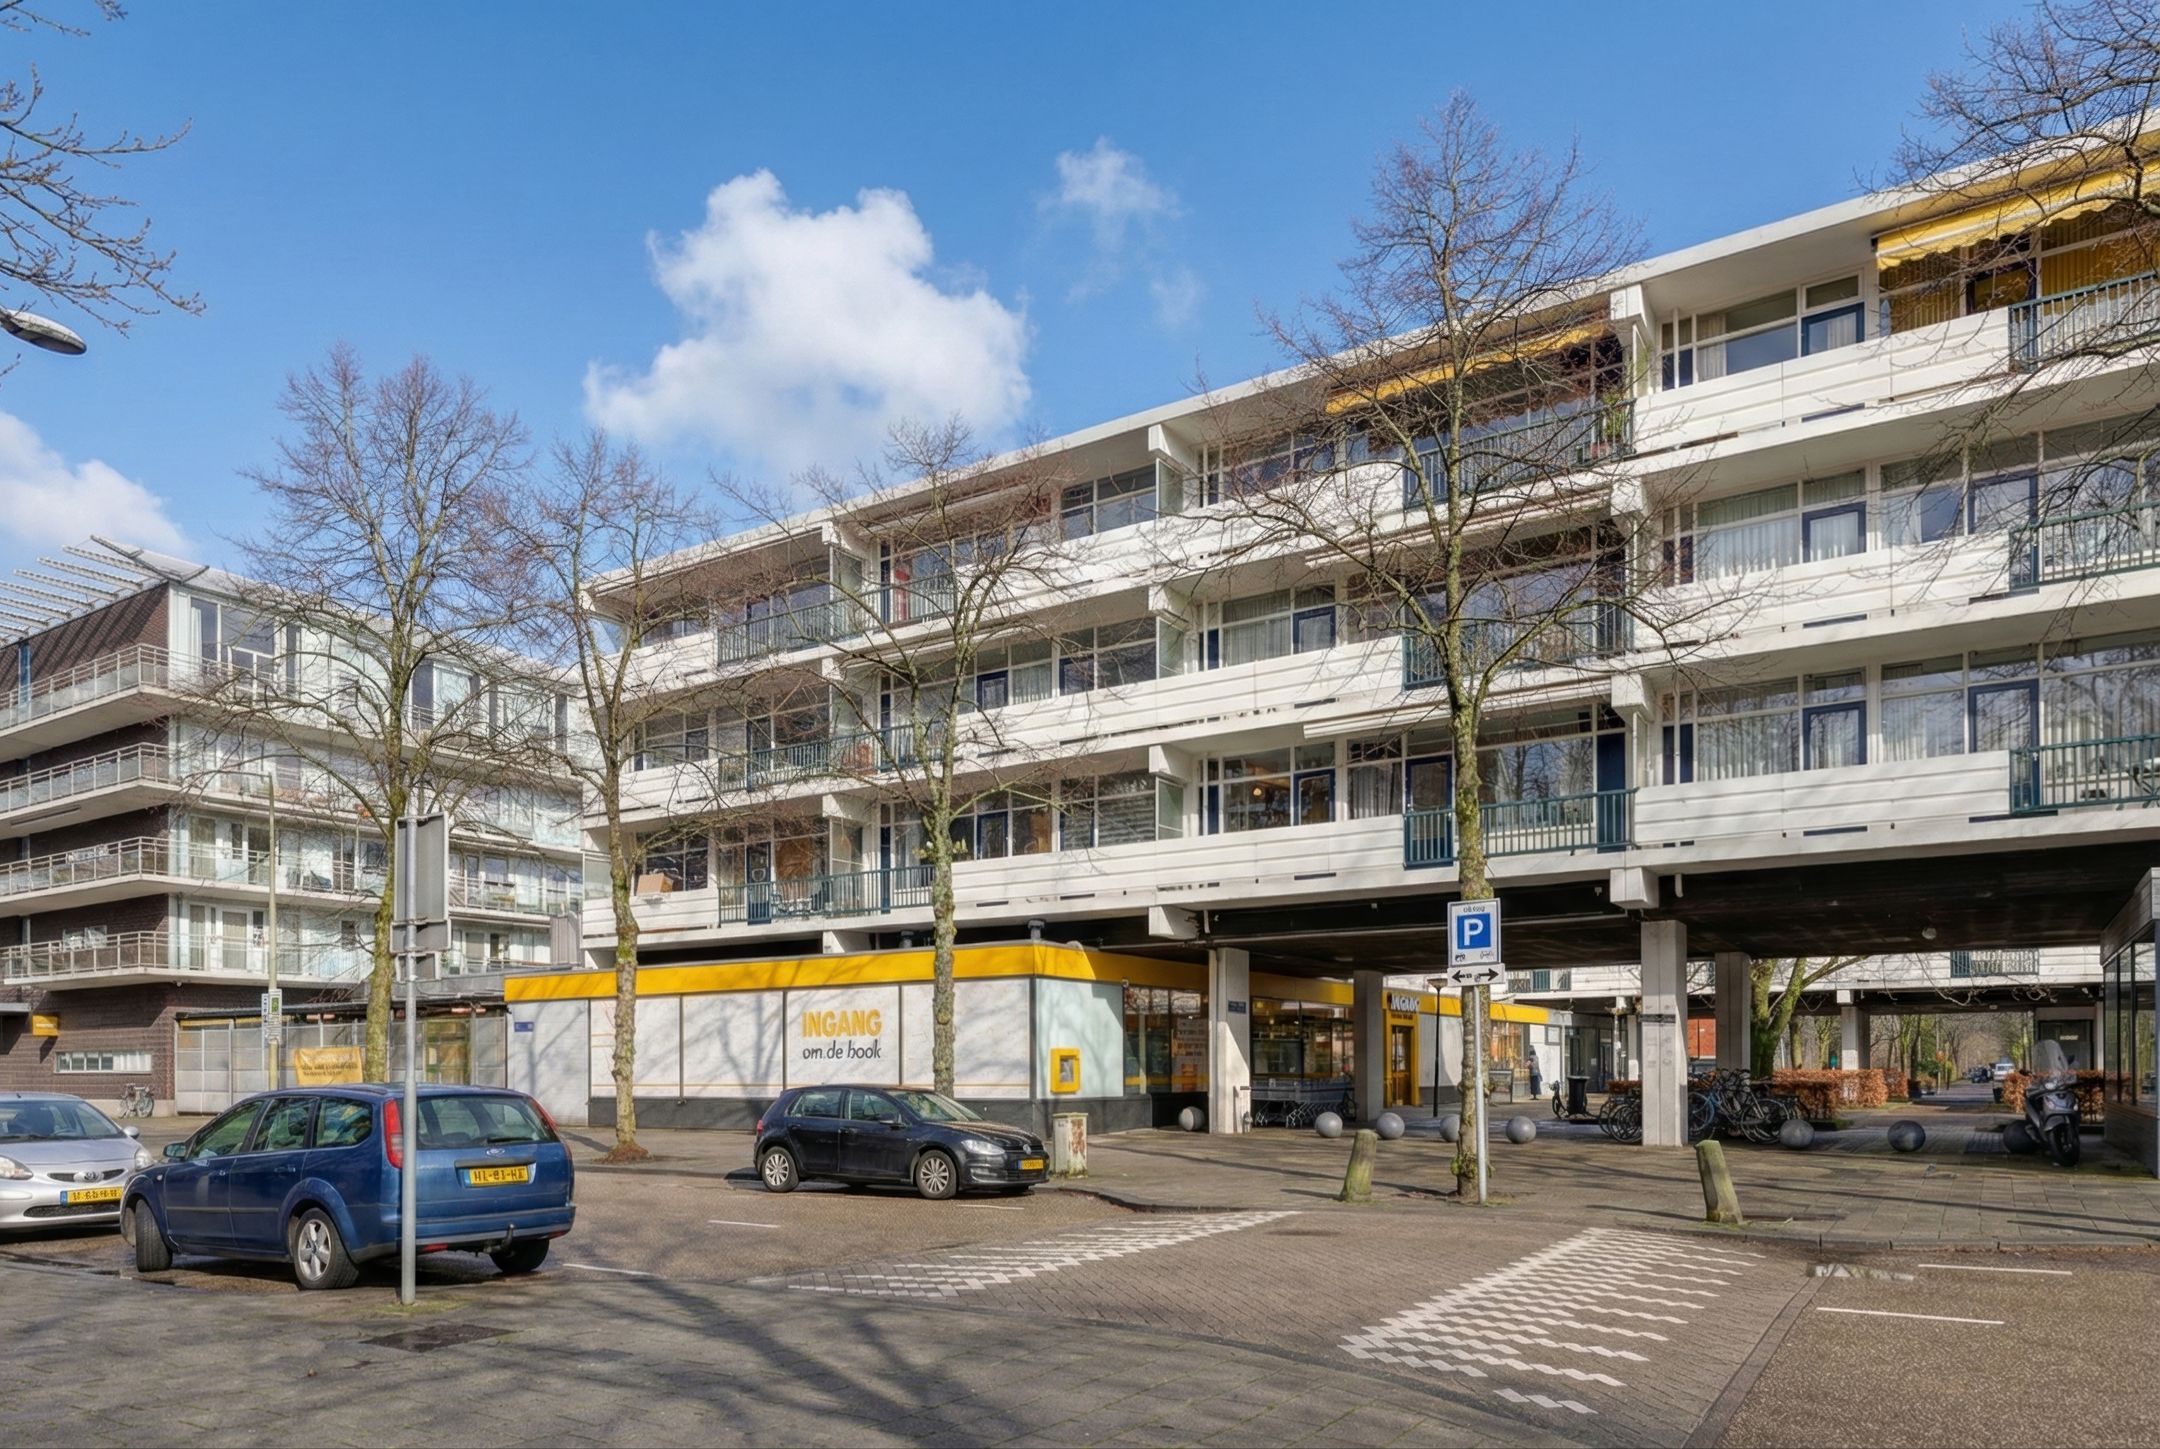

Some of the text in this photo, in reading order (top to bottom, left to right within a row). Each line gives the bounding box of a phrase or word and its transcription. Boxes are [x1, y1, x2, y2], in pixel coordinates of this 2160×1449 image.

[1464, 918, 1484, 946] P
[802, 1008, 882, 1037] INGANG
[802, 1047, 823, 1059] om
[826, 1039, 844, 1059] de
